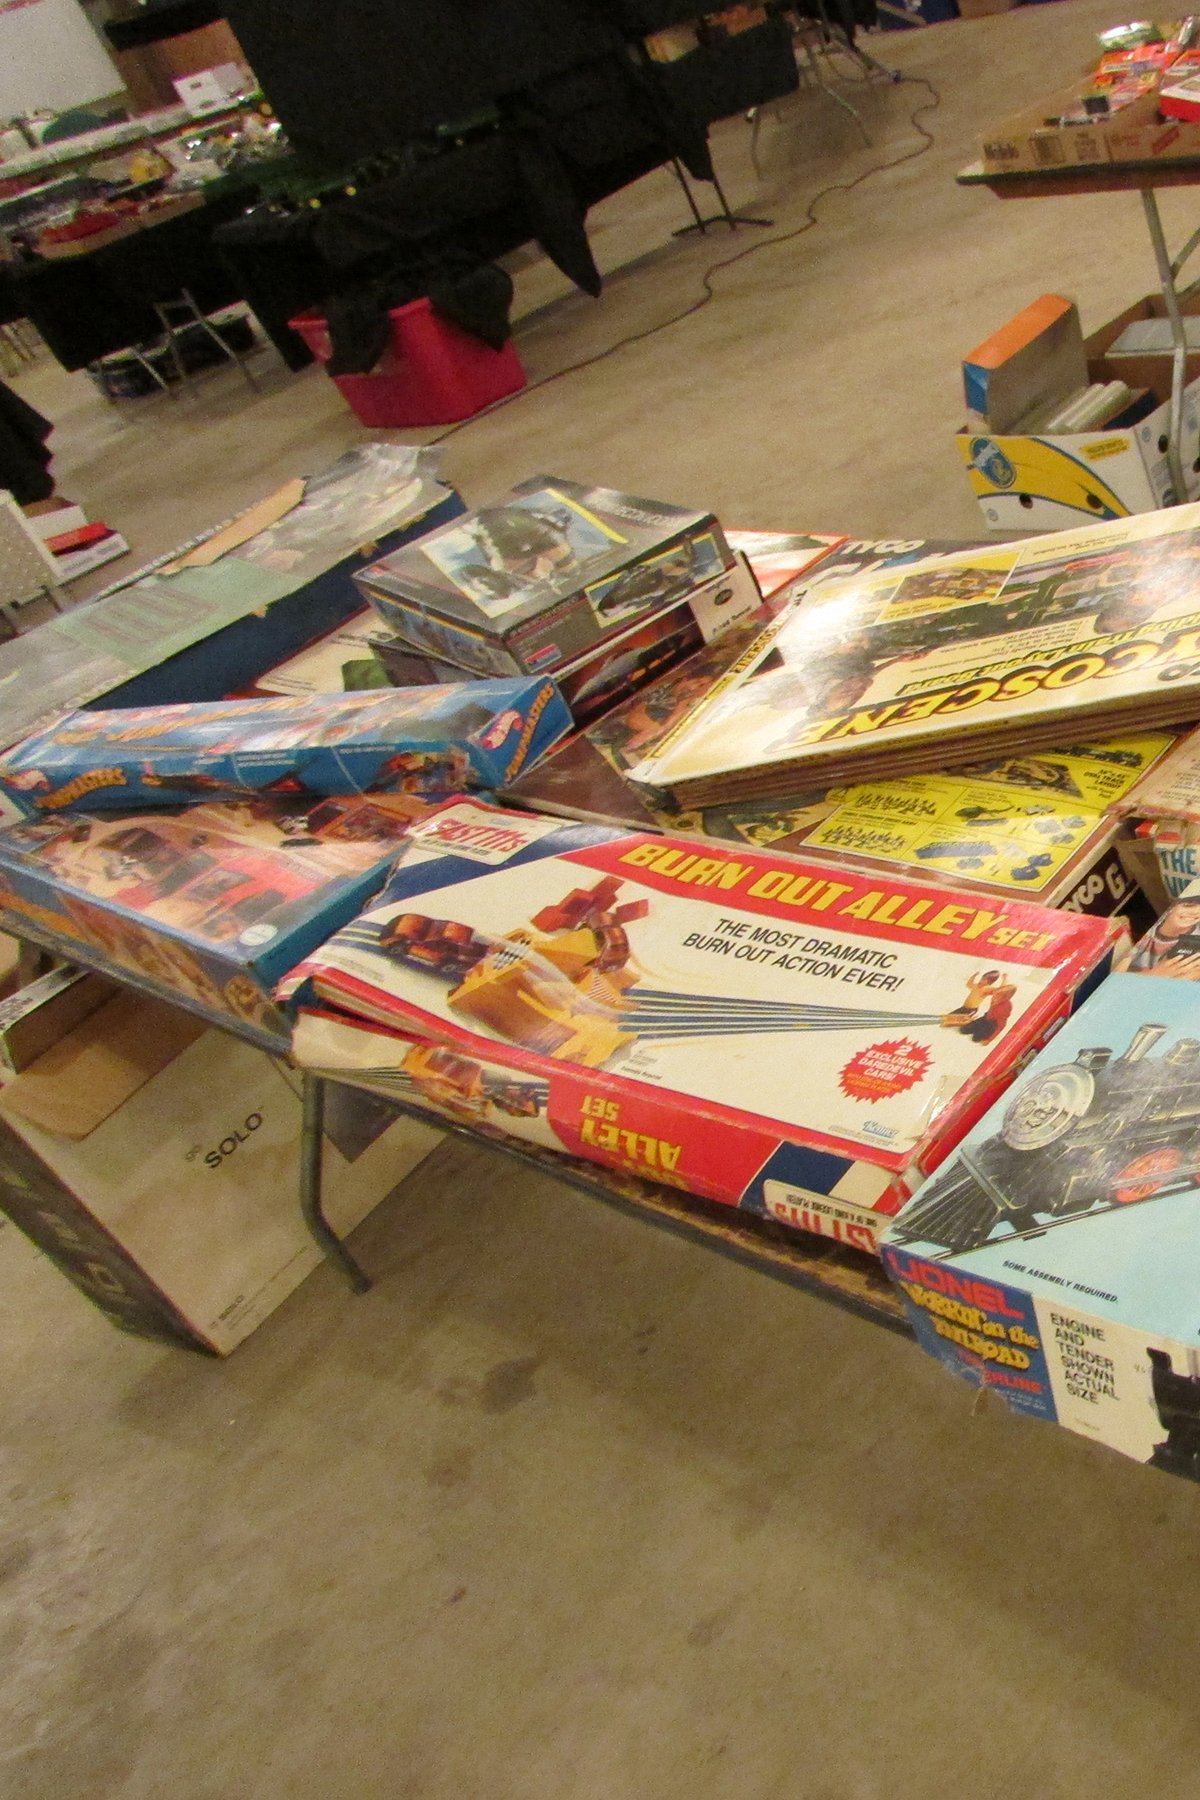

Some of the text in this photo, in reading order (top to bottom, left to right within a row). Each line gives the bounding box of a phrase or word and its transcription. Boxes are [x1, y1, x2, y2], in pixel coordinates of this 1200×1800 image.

[1155, 847, 1198, 876] THE
[618, 842, 1056, 952] BURN OUT ALLEY SET
[713, 918, 899, 969] THE MOST DRAMATIC
[683, 932, 905, 993] BURN OUT ACTION EVER!
[864, 1050, 923, 1070] EXCLUSIVE
[893, 1044, 914, 1057] 2
[858, 1058, 915, 1077] DAREDEVIL
[580, 1094, 621, 1122] SET
[204, 1112, 264, 1169] SOLO
[580, 1118, 682, 1172] ALLEY
[886, 1251, 1026, 1320] LIONEL
[1002, 1259, 1119, 1305] SOME ASSEMBLY REQUIRED.
[1050, 1311, 1107, 1343] ENGINE
[1054, 1327, 1086, 1347] AND
[1055, 1340, 1115, 1372] TENDER
[1060, 1354, 1116, 1386] SHOWN
[1064, 1369, 1121, 1401] ACTUAL
[1066, 1382, 1100, 1405] SIZE
